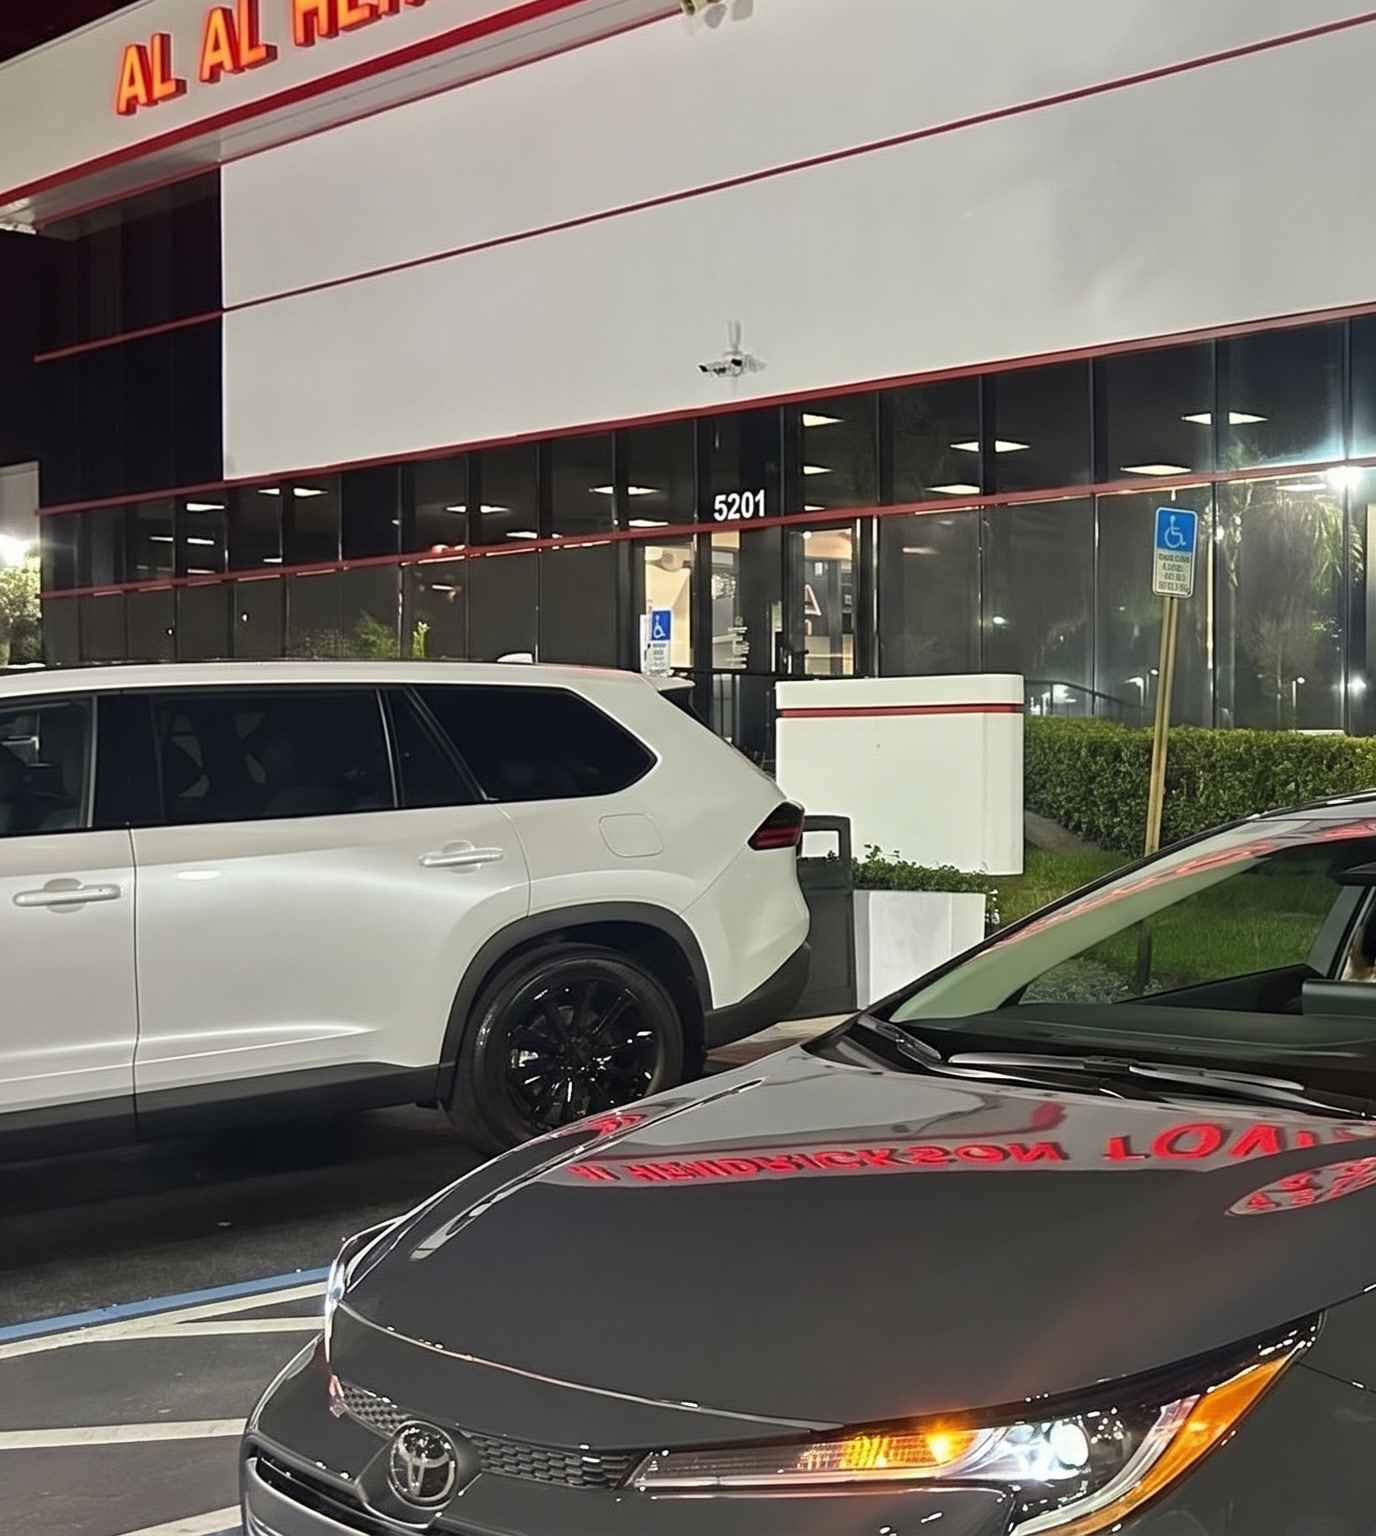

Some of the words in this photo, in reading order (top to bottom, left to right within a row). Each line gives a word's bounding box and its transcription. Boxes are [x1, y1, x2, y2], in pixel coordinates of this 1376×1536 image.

[115, 32, 187, 116] AL
[199, 0, 277, 83] AL
[713, 489, 765, 521] 5201
